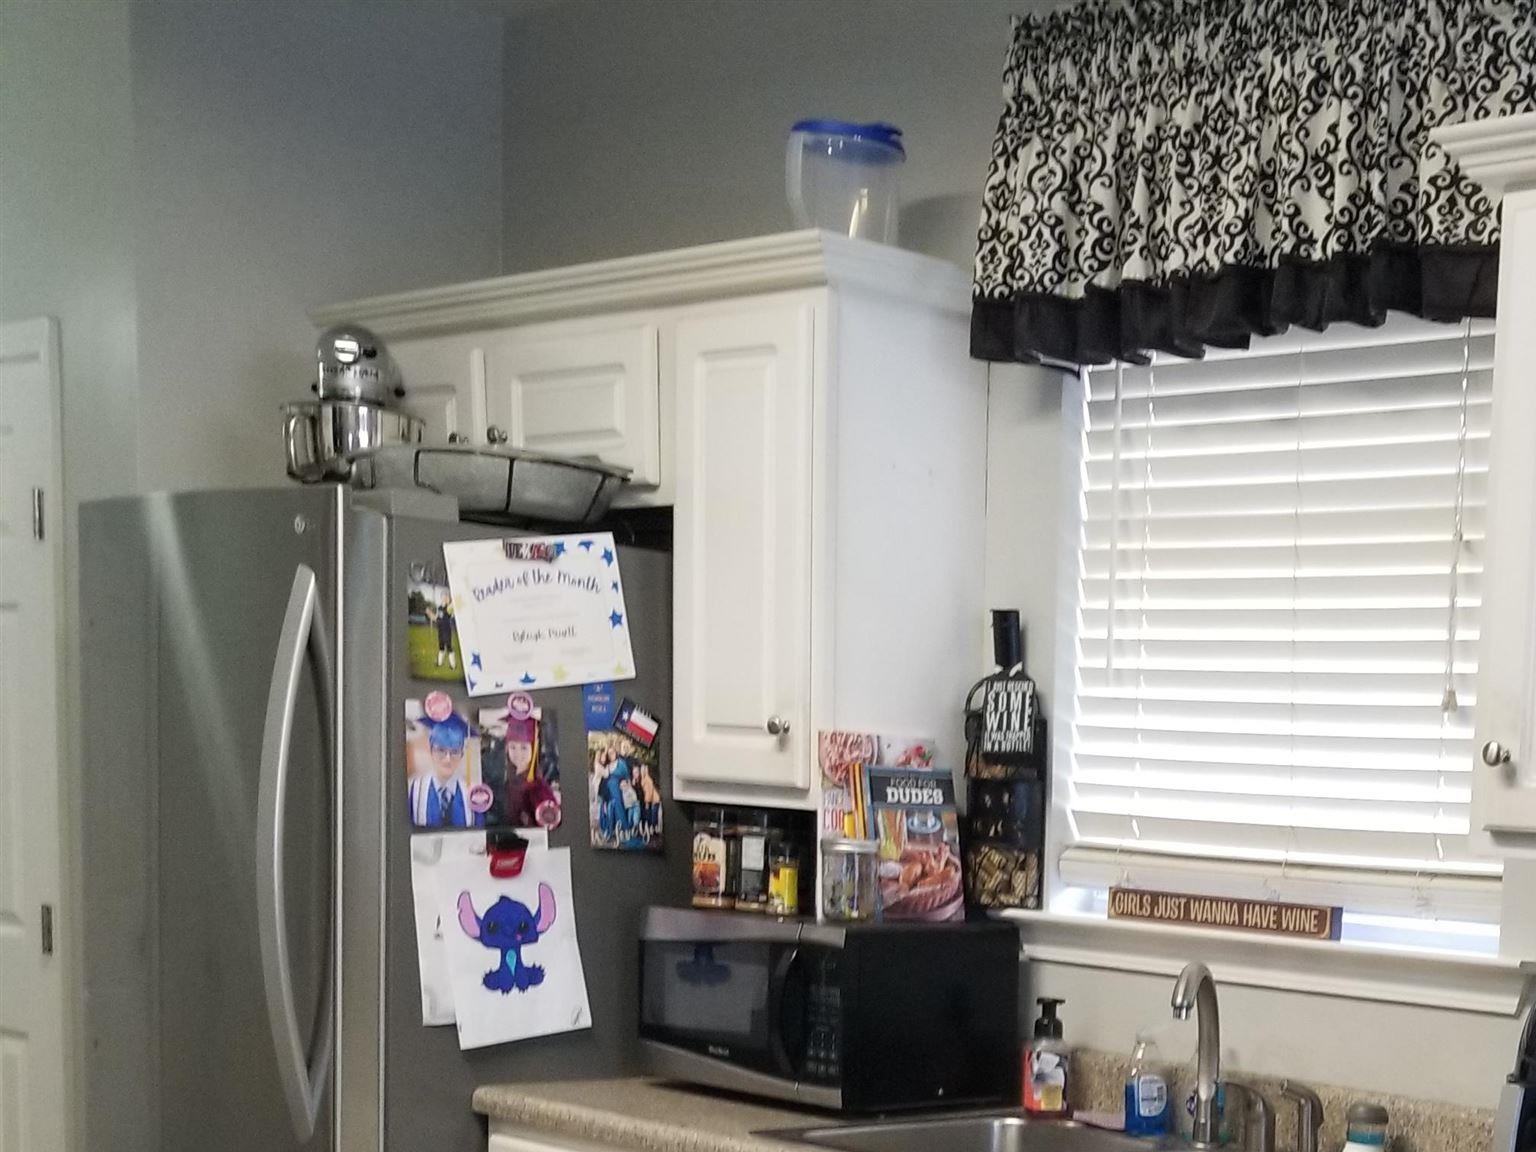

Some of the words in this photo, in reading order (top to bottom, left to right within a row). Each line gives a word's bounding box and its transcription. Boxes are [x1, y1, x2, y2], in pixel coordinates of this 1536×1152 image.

[517, 570, 528, 586] of
[532, 568, 552, 584] the
[558, 570, 600, 594] Month
[987, 691, 1032, 714] SOME
[986, 710, 1030, 732] WINE
[886, 786, 944, 805] DUDES
[1115, 892, 1151, 917] GIRLS
[1154, 896, 1185, 921] JUST
[1190, 898, 1239, 925] WANNA
[1243, 902, 1278, 929] HAVE
[1281, 908, 1319, 933] WINE
